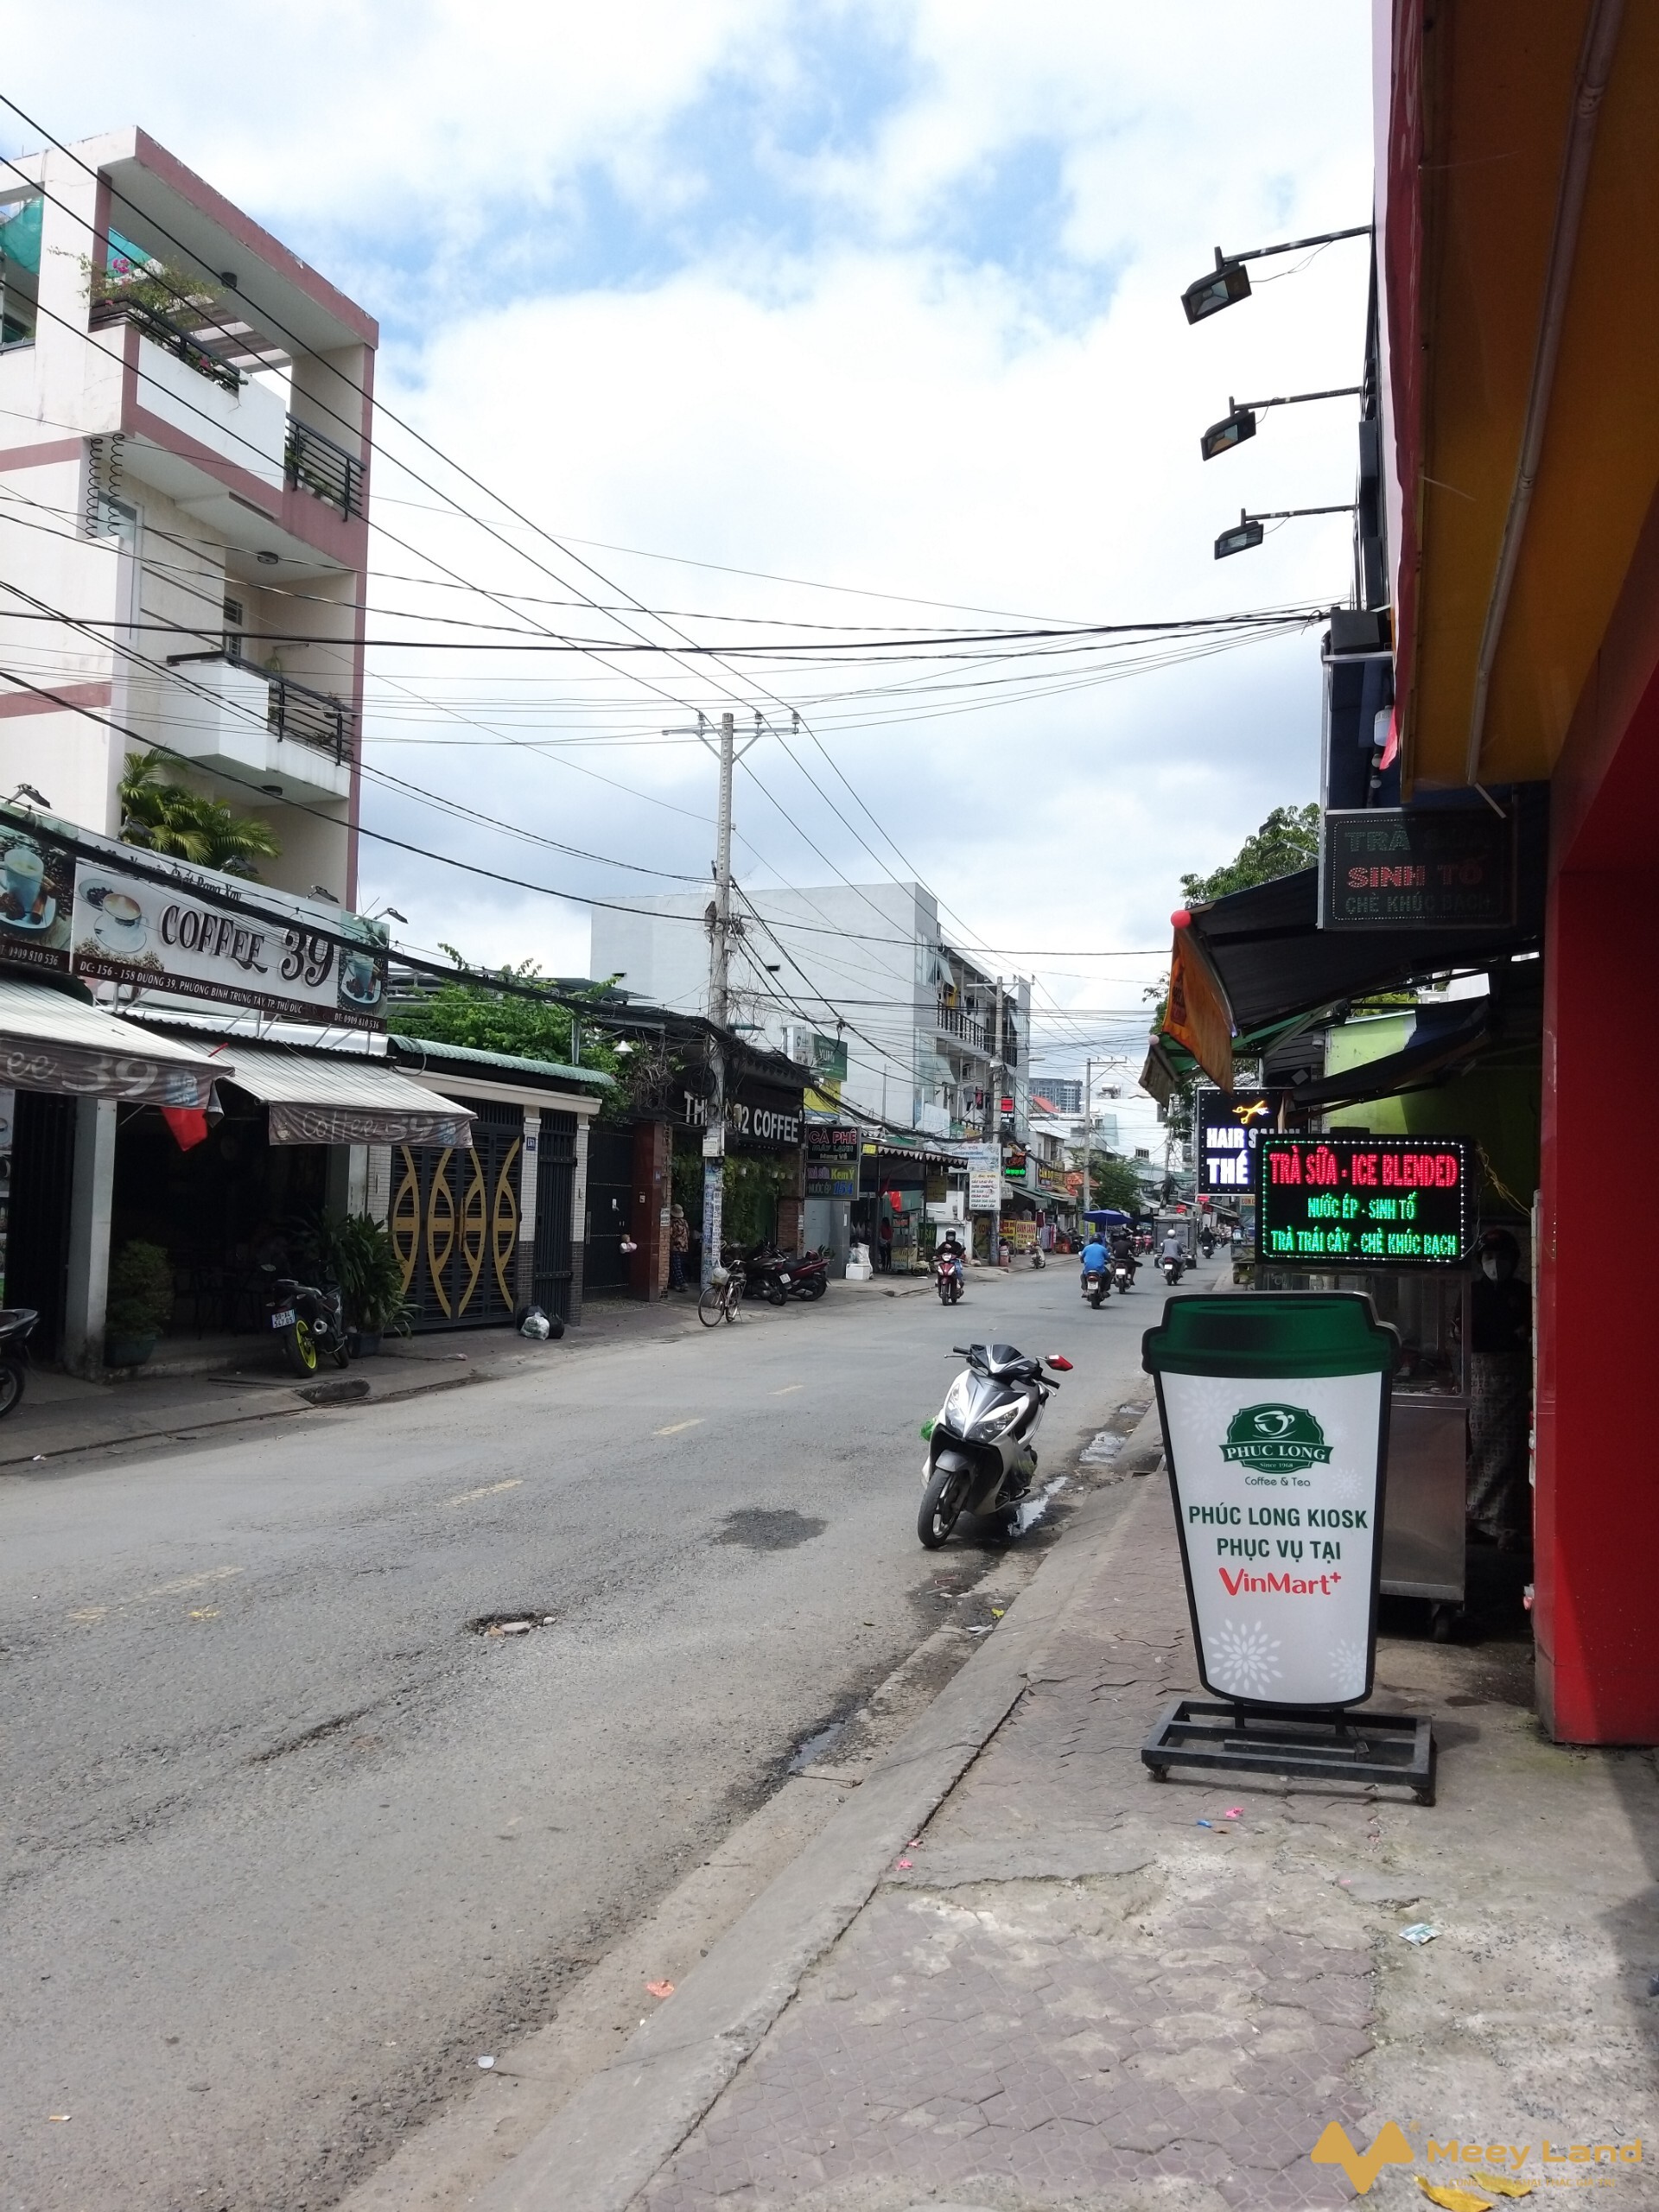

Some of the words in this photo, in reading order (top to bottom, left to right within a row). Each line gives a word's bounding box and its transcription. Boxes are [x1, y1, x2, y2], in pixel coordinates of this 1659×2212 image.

[1348, 866, 1426, 887] SINH
[9, 946, 27, 958] 0909
[28, 950, 43, 963] 810
[43, 954, 60, 966] 536
[160, 905, 268, 973] COFFEE
[280, 927, 334, 988] 39
[96, 964, 112, 976] 156
[120, 969, 135, 981] 158
[165, 978, 177, 989] 39,
[344, 1014, 357, 1025] 0909
[369, 1020, 379, 1029] 536
[61, 1056, 158, 1096] 39
[753, 1109, 799, 1143] COFFEE
[809, 1128, 830, 1144] CÀ
[832, 1128, 856, 1144] PHÊ
[1206, 1128, 1244, 1148] HAIR
[830, 1168, 848, 1180] Kem
[1269, 1145, 1301, 1185] TRÀ
[1305, 1146, 1338, 1185] SỮA
[1351, 1154, 1378, 1185] ICE
[1382, 1154, 1458, 1187] BLENDED
[1307, 1192, 1340, 1219] NƯỚC
[1342, 1192, 1360, 1219] ÉP
[1369, 1198, 1397, 1219] SINH
[1398, 1191, 1418, 1220] TỐ
[1271, 1225, 1296, 1252] TRÀ
[1297, 1225, 1325, 1252] TRÁI
[1326, 1226, 1351, 1253] CÂY
[1360, 1227, 1382, 1254] CHÈ
[1387, 1228, 1421, 1255] KHÚC
[1423, 1234, 1458, 1258] BẠCH
[1225, 1445, 1273, 1459] PHUC
[1279, 1445, 1325, 1460] LONG
[1244, 1476, 1277, 1486] Coffee
[1280, 1477, 1288, 1486] &
[1291, 1477, 1311, 1487] Tea
[1189, 1502, 1242, 1525] PHÚC
[1249, 1507, 1300, 1527] LONG
[1307, 1509, 1369, 1529] KIOSK
[1217, 1537, 1270, 1561] PHỤC
[1276, 1539, 1303, 1563] VỤ
[1309, 1541, 1341, 1564] TẠI
